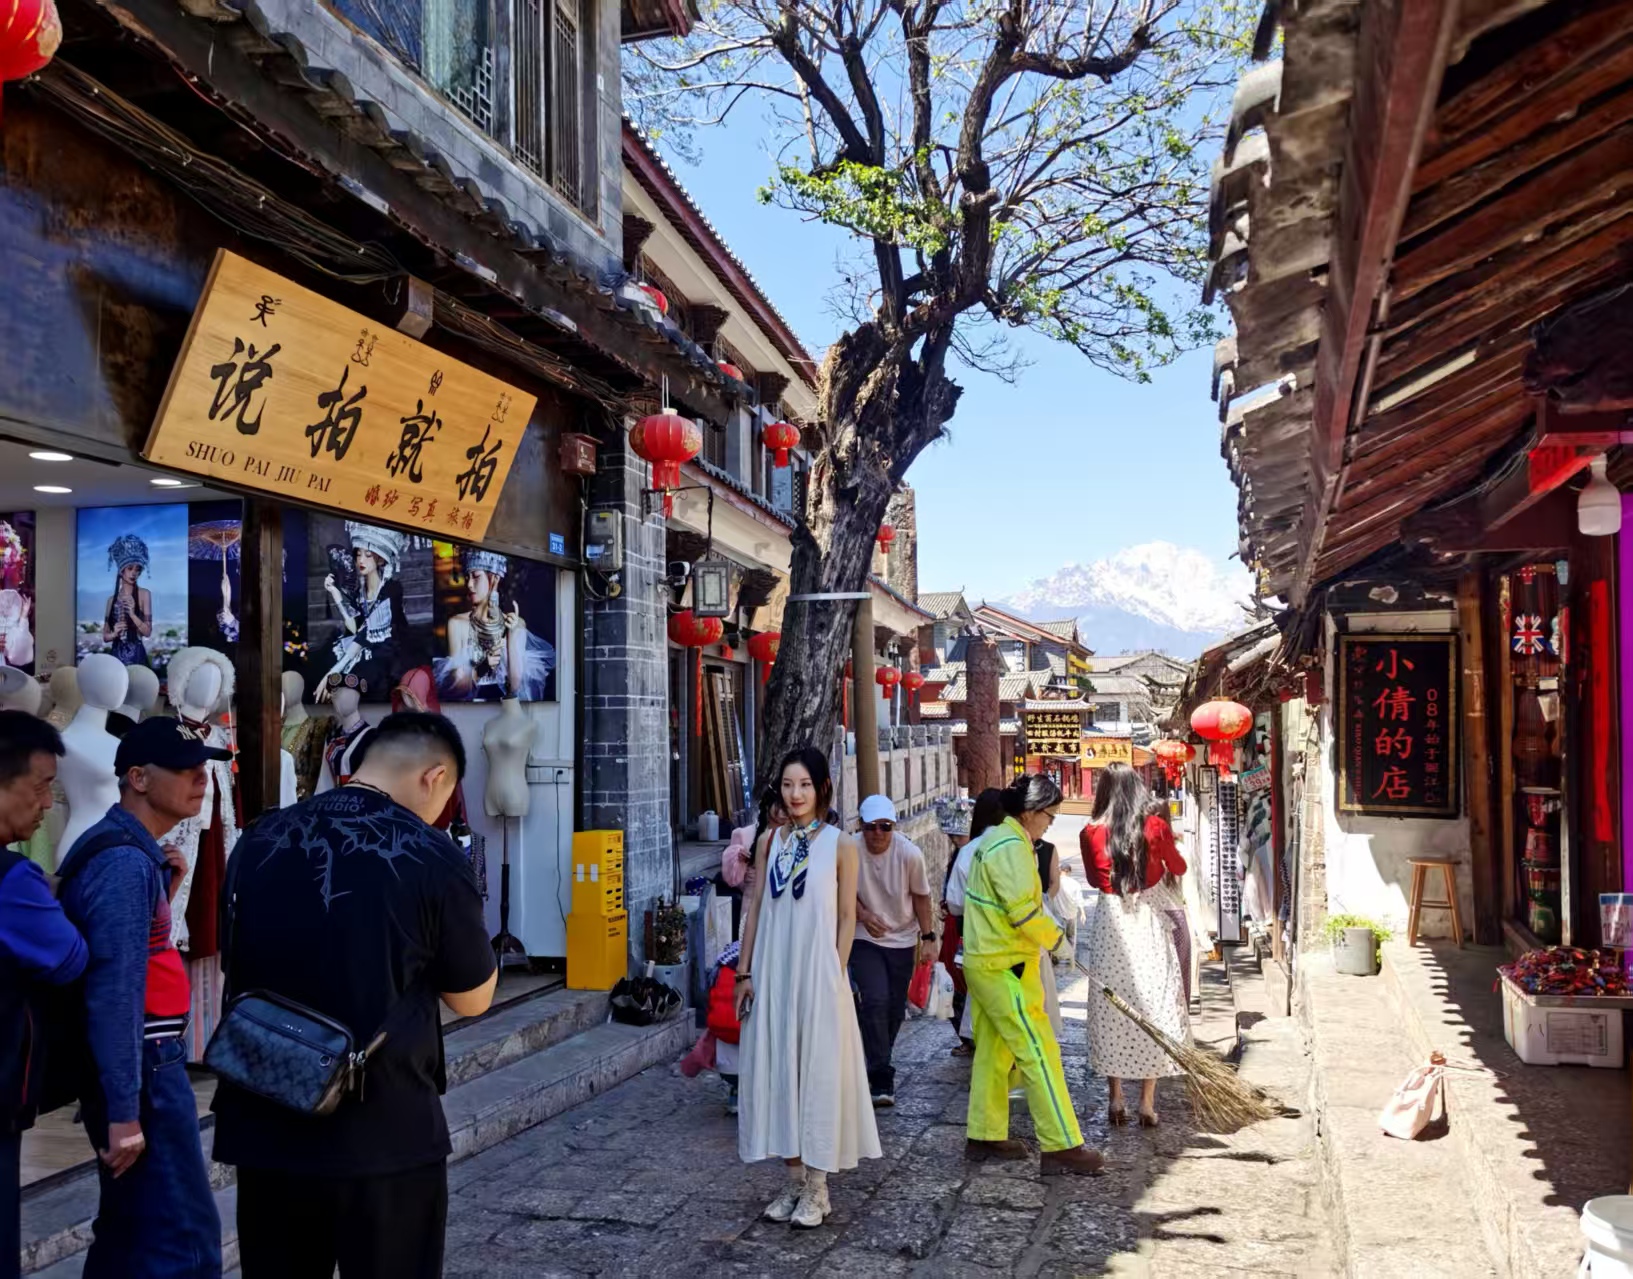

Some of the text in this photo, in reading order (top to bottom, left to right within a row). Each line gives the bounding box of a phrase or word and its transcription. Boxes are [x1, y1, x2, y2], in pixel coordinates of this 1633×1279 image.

[208, 337, 502, 502] 说拍就拍
[185, 441, 332, 492] SHUO PAI JIU PAI
[408, 496, 438, 523] 写真
[1372, 649, 1417, 799] 小倩的店
[307, 802, 360, 813] STUDIO
